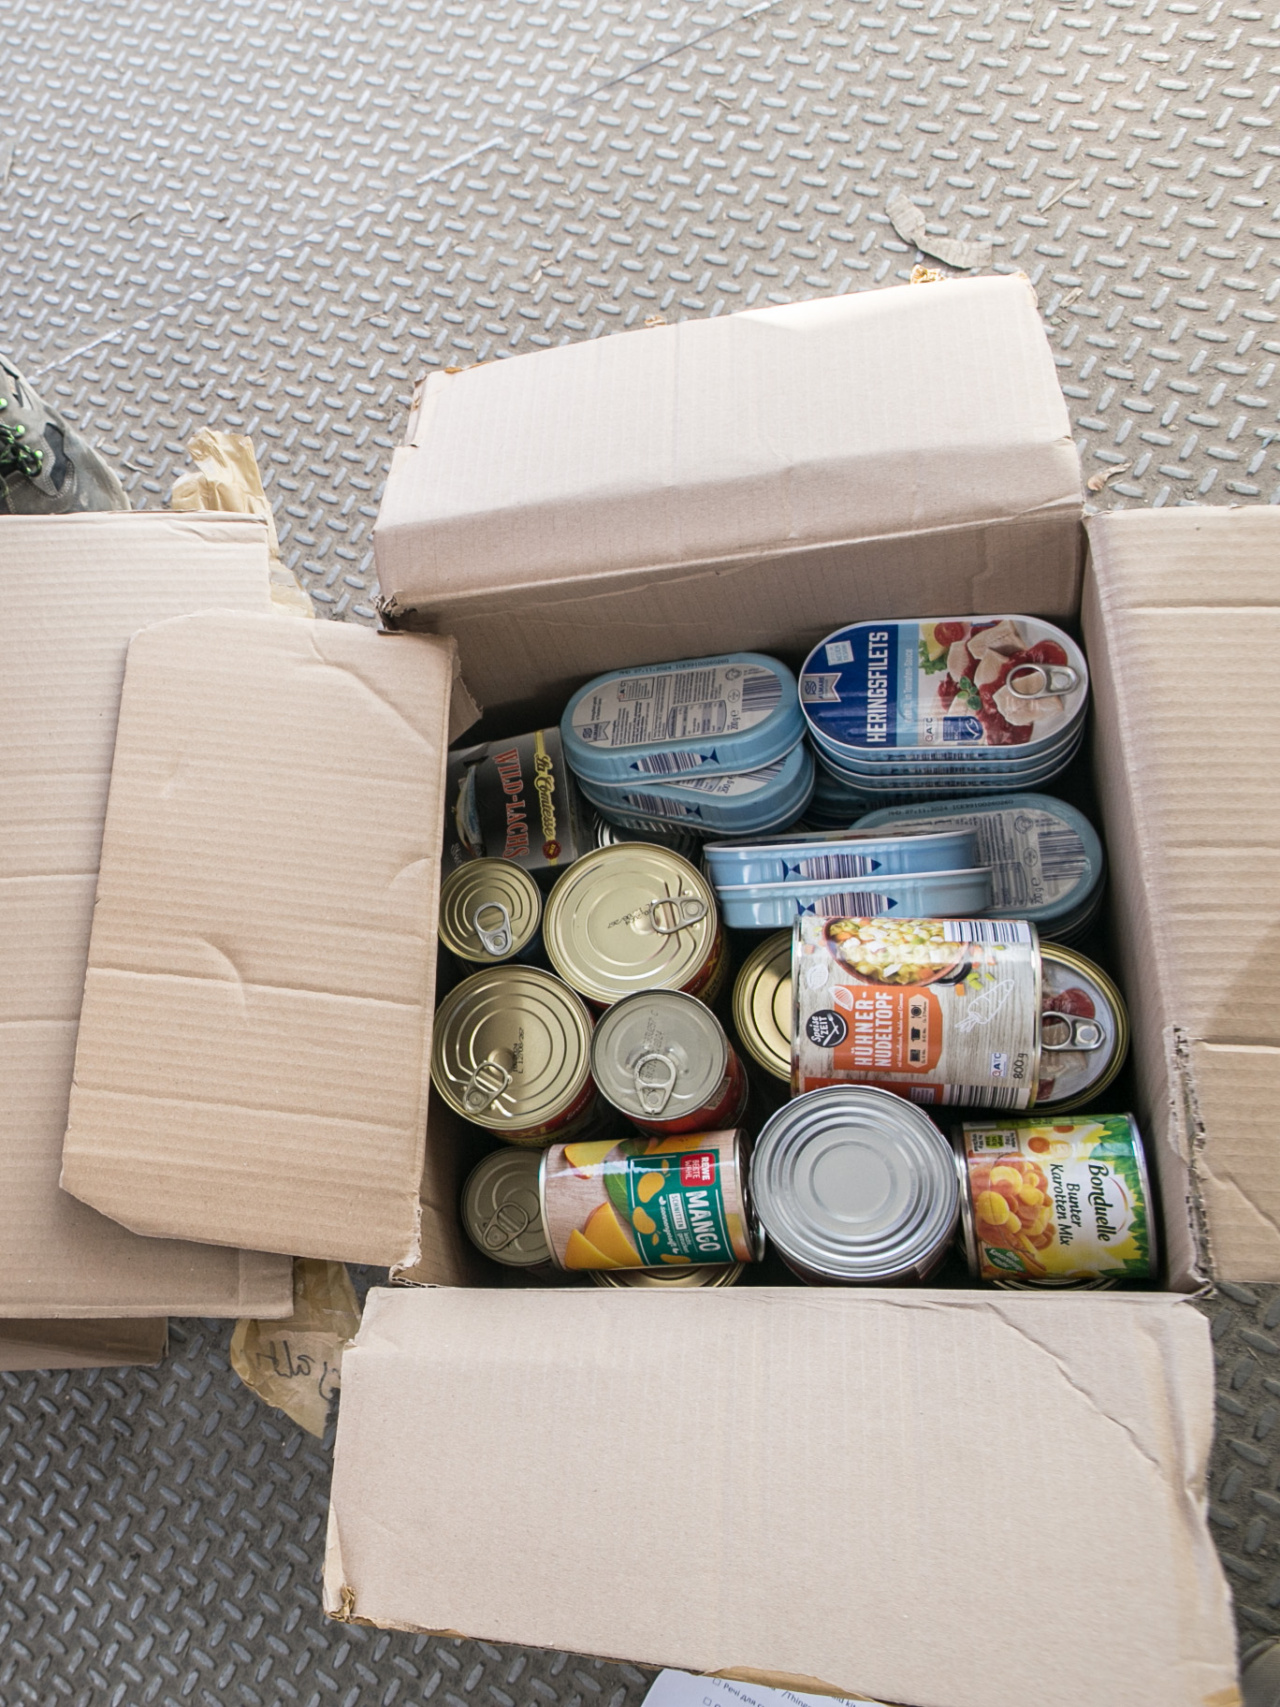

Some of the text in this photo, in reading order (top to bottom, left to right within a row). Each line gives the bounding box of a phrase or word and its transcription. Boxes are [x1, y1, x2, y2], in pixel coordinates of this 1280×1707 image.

[866, 631, 888, 743] HERINGSFILETS
[536, 754, 553, 773] La
[492, 747, 531, 860] WILD-LACHS
[1034, 892, 1044, 904] 200
[810, 1015, 824, 1043] Speise
[819, 1015, 828, 1035] ZEIT
[850, 991, 874, 1066] HÜHNER-
[874, 991, 893, 1067] NUDELTOPF
[1013, 1060, 1025, 1079] 800
[683, 1160, 692, 1180] WAHL
[692, 1158, 701, 1179] BESTE
[700, 1156, 711, 1181] REWE
[671, 1194, 686, 1229] SCHNITTEN
[685, 1190, 721, 1253] MANGO
[1049, 1163, 1074, 1246] Karotten Mix
[1066, 1182, 1082, 1228] Bunter
[1088, 1163, 1117, 1242] Bonduelle
[658, 1205, 676, 1250] sonnengereift
